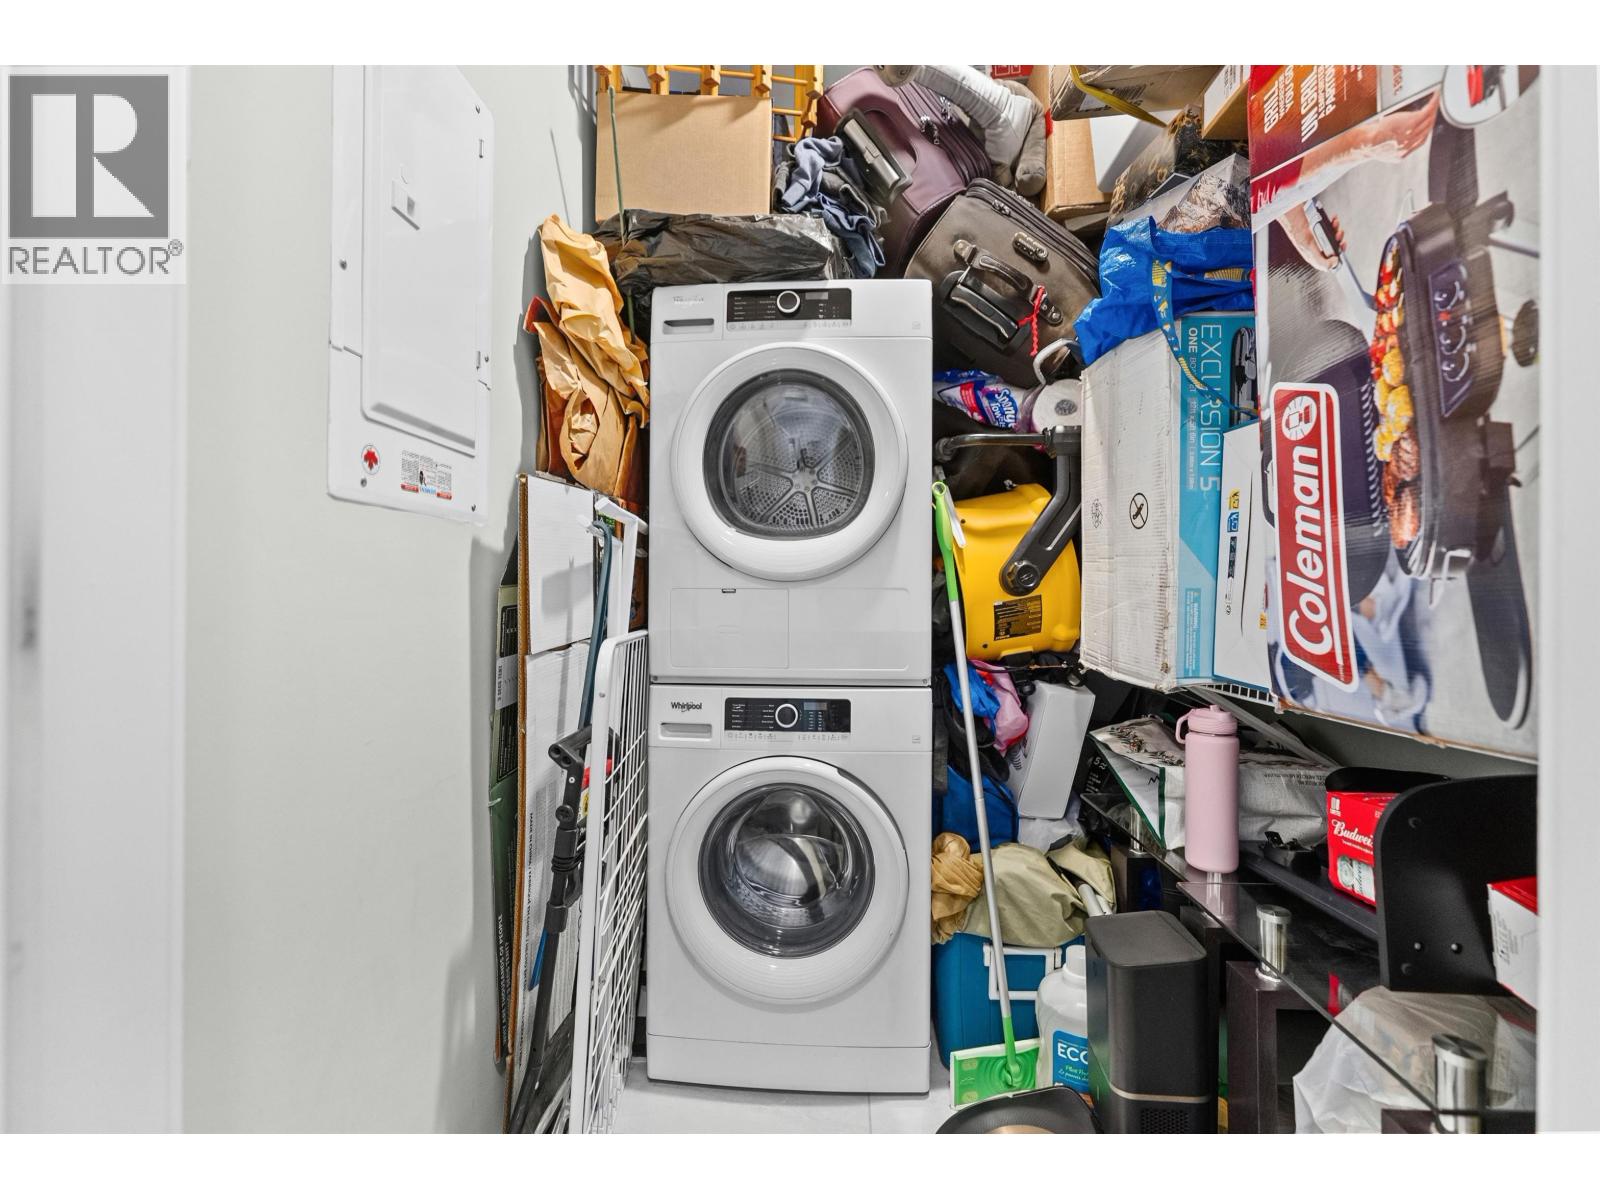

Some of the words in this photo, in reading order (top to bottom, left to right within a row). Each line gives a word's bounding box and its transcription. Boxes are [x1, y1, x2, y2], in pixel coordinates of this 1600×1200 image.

[1263, 80, 1279, 134] GRILL
[1284, 82, 1295, 113] YOU
[1300, 65, 1318, 115] GRIL
[1300, 106, 1318, 143] UN
[1188, 327, 1198, 353] ONE
[1199, 476, 1221, 492] 5
[1285, 444, 1334, 656] Coleman
[670, 701, 703, 713] Whirlpool
